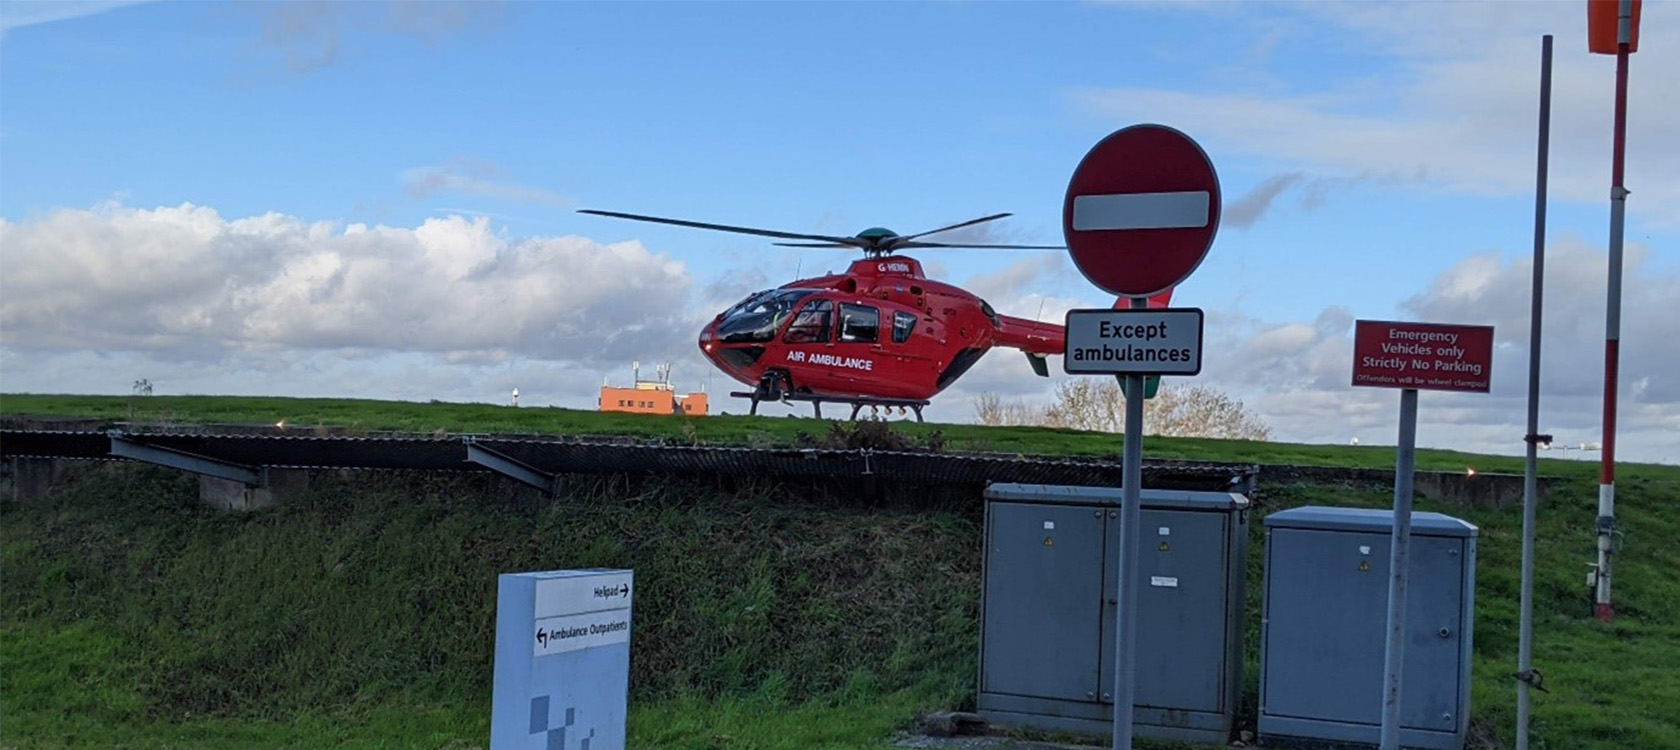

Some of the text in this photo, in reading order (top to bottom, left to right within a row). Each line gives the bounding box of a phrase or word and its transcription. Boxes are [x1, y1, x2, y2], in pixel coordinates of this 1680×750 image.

[1099, 321, 1168, 341] Except
[1389, 328, 1458, 344] Emergency
[1073, 344, 1191, 362] ambulances
[1381, 342, 1465, 359] Vehicles only
[787, 350, 873, 371] AIR AMBULANCE
[1362, 356, 1482, 375] Strictly No Parking
[1356, 374, 1487, 388] Offenders will be wheel clamped
[593, 584, 619, 600] Helipad
[549, 620, 627, 641] Ambulance Outpatients
